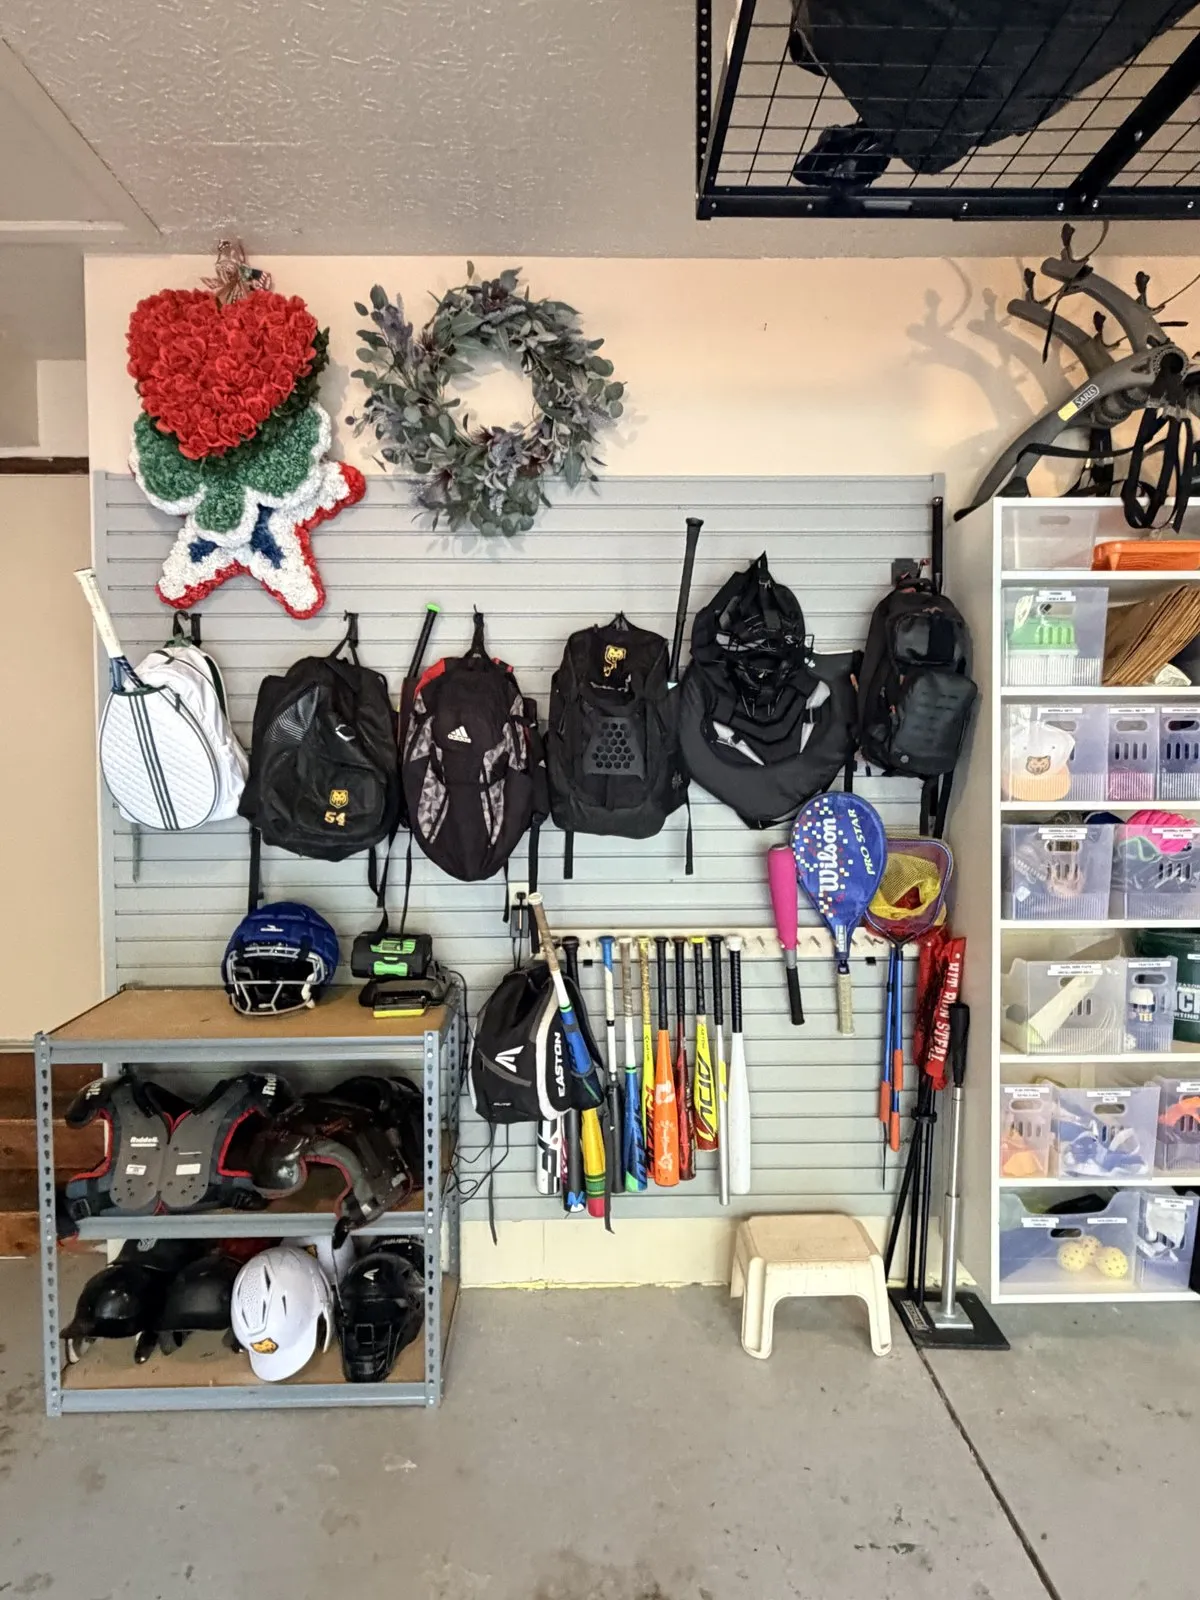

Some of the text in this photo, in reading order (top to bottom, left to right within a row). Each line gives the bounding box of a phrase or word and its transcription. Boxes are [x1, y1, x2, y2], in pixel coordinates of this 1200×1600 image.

[1075, 386, 1097, 408] SARIS
[324, 811, 346, 826] 54
[848, 809, 876, 875] PRO STAR
[817, 817, 839, 891] Wilson
[554, 1031, 566, 1098] EASTON
